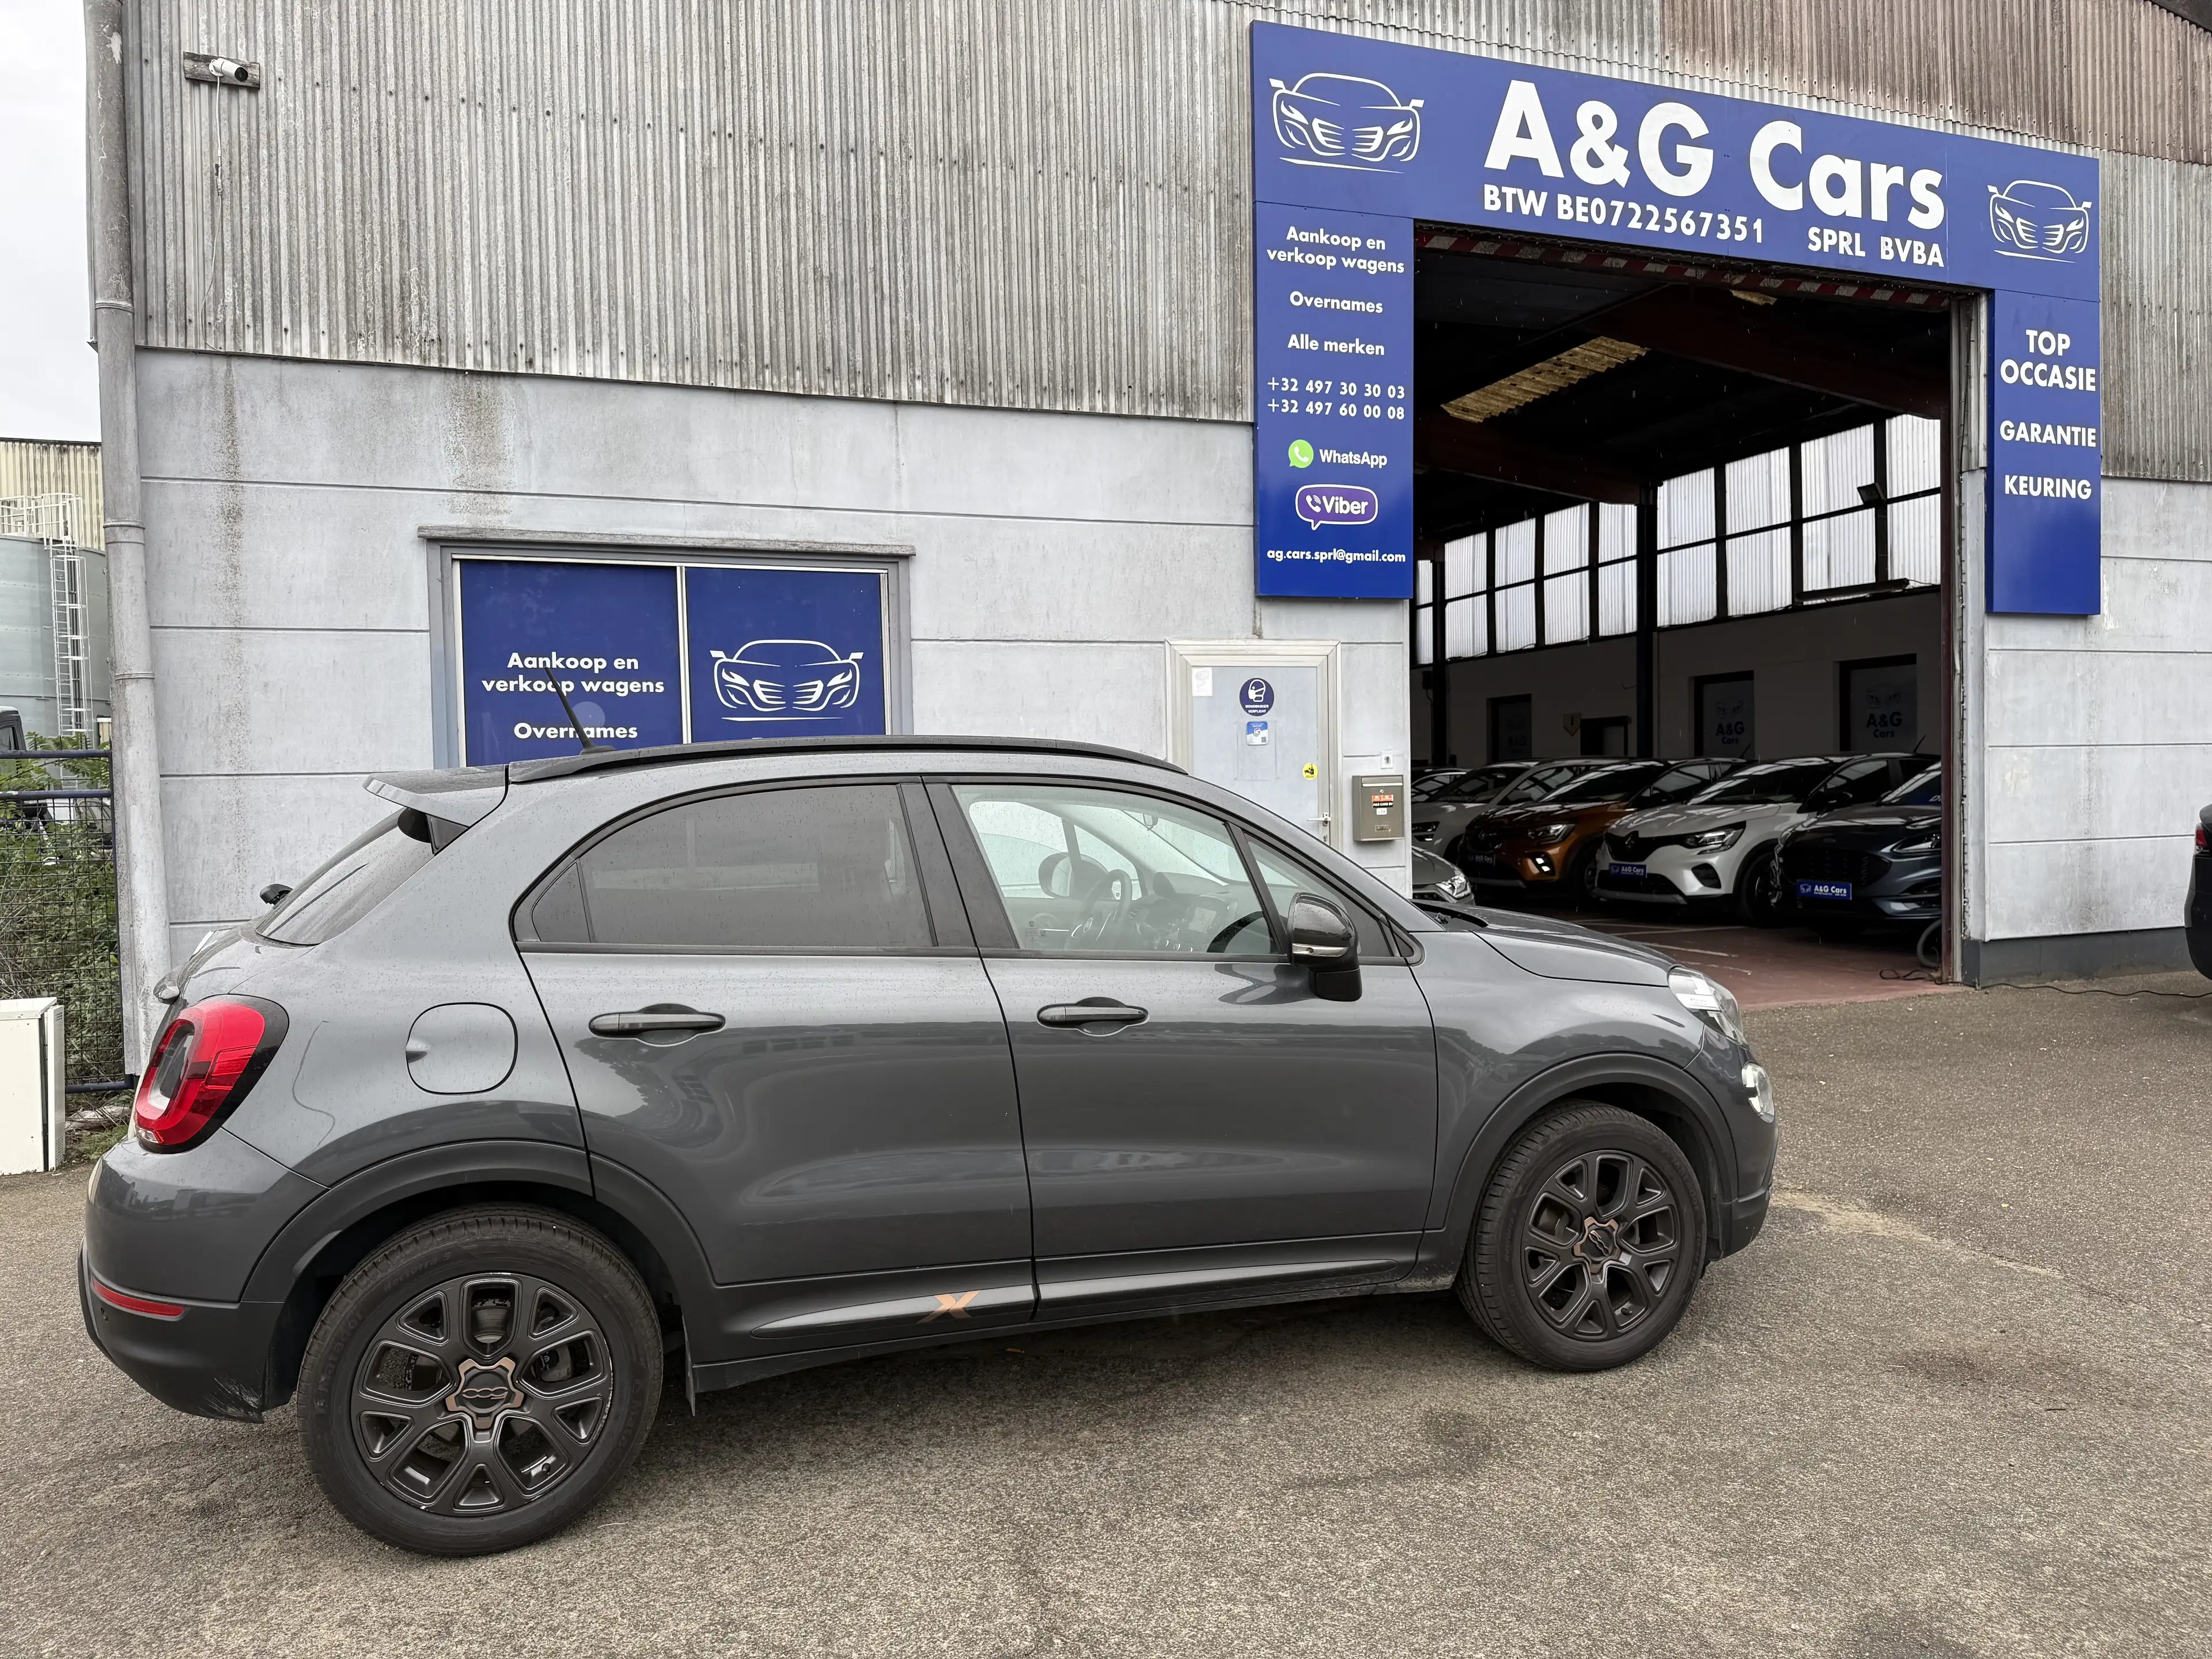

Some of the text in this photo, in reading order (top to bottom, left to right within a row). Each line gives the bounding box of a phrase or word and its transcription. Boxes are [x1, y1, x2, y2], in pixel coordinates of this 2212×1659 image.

[1484, 79, 1946, 230] A&G Cars
[1484, 183, 1763, 244] BTW BE0722567351
[1286, 226, 1386, 251] Aankoop en
[1808, 226, 1945, 268] SPRL BVBA
[1267, 247, 1404, 275] verkoop wagens
[1289, 290, 1383, 313] Overnames
[1287, 333, 1385, 356] Alle merken
[2025, 329, 2071, 357] TOP
[2000, 359, 2096, 392] OCCASIE
[1267, 377, 1405, 399] +32 497 30 30 03
[1267, 398, 1405, 420] +32 497 60 00 08
[1999, 420, 2096, 448] GARANTIE
[1319, 449, 1388, 469] WhatsApp
[2005, 475, 2092, 500] KEURING
[1322, 495, 1369, 515] Viber
[1267, 548, 1406, 564] ag.cars.sprl@gmail.com
[507, 651, 639, 674] Aankoop en
[481, 674, 665, 697] verkoop wagens
[514, 722, 638, 739] Overnames
[1716, 721, 1744, 735] A&G
[1866, 711, 1902, 728] A&G
[1813, 884, 1847, 894] A&G Cars
